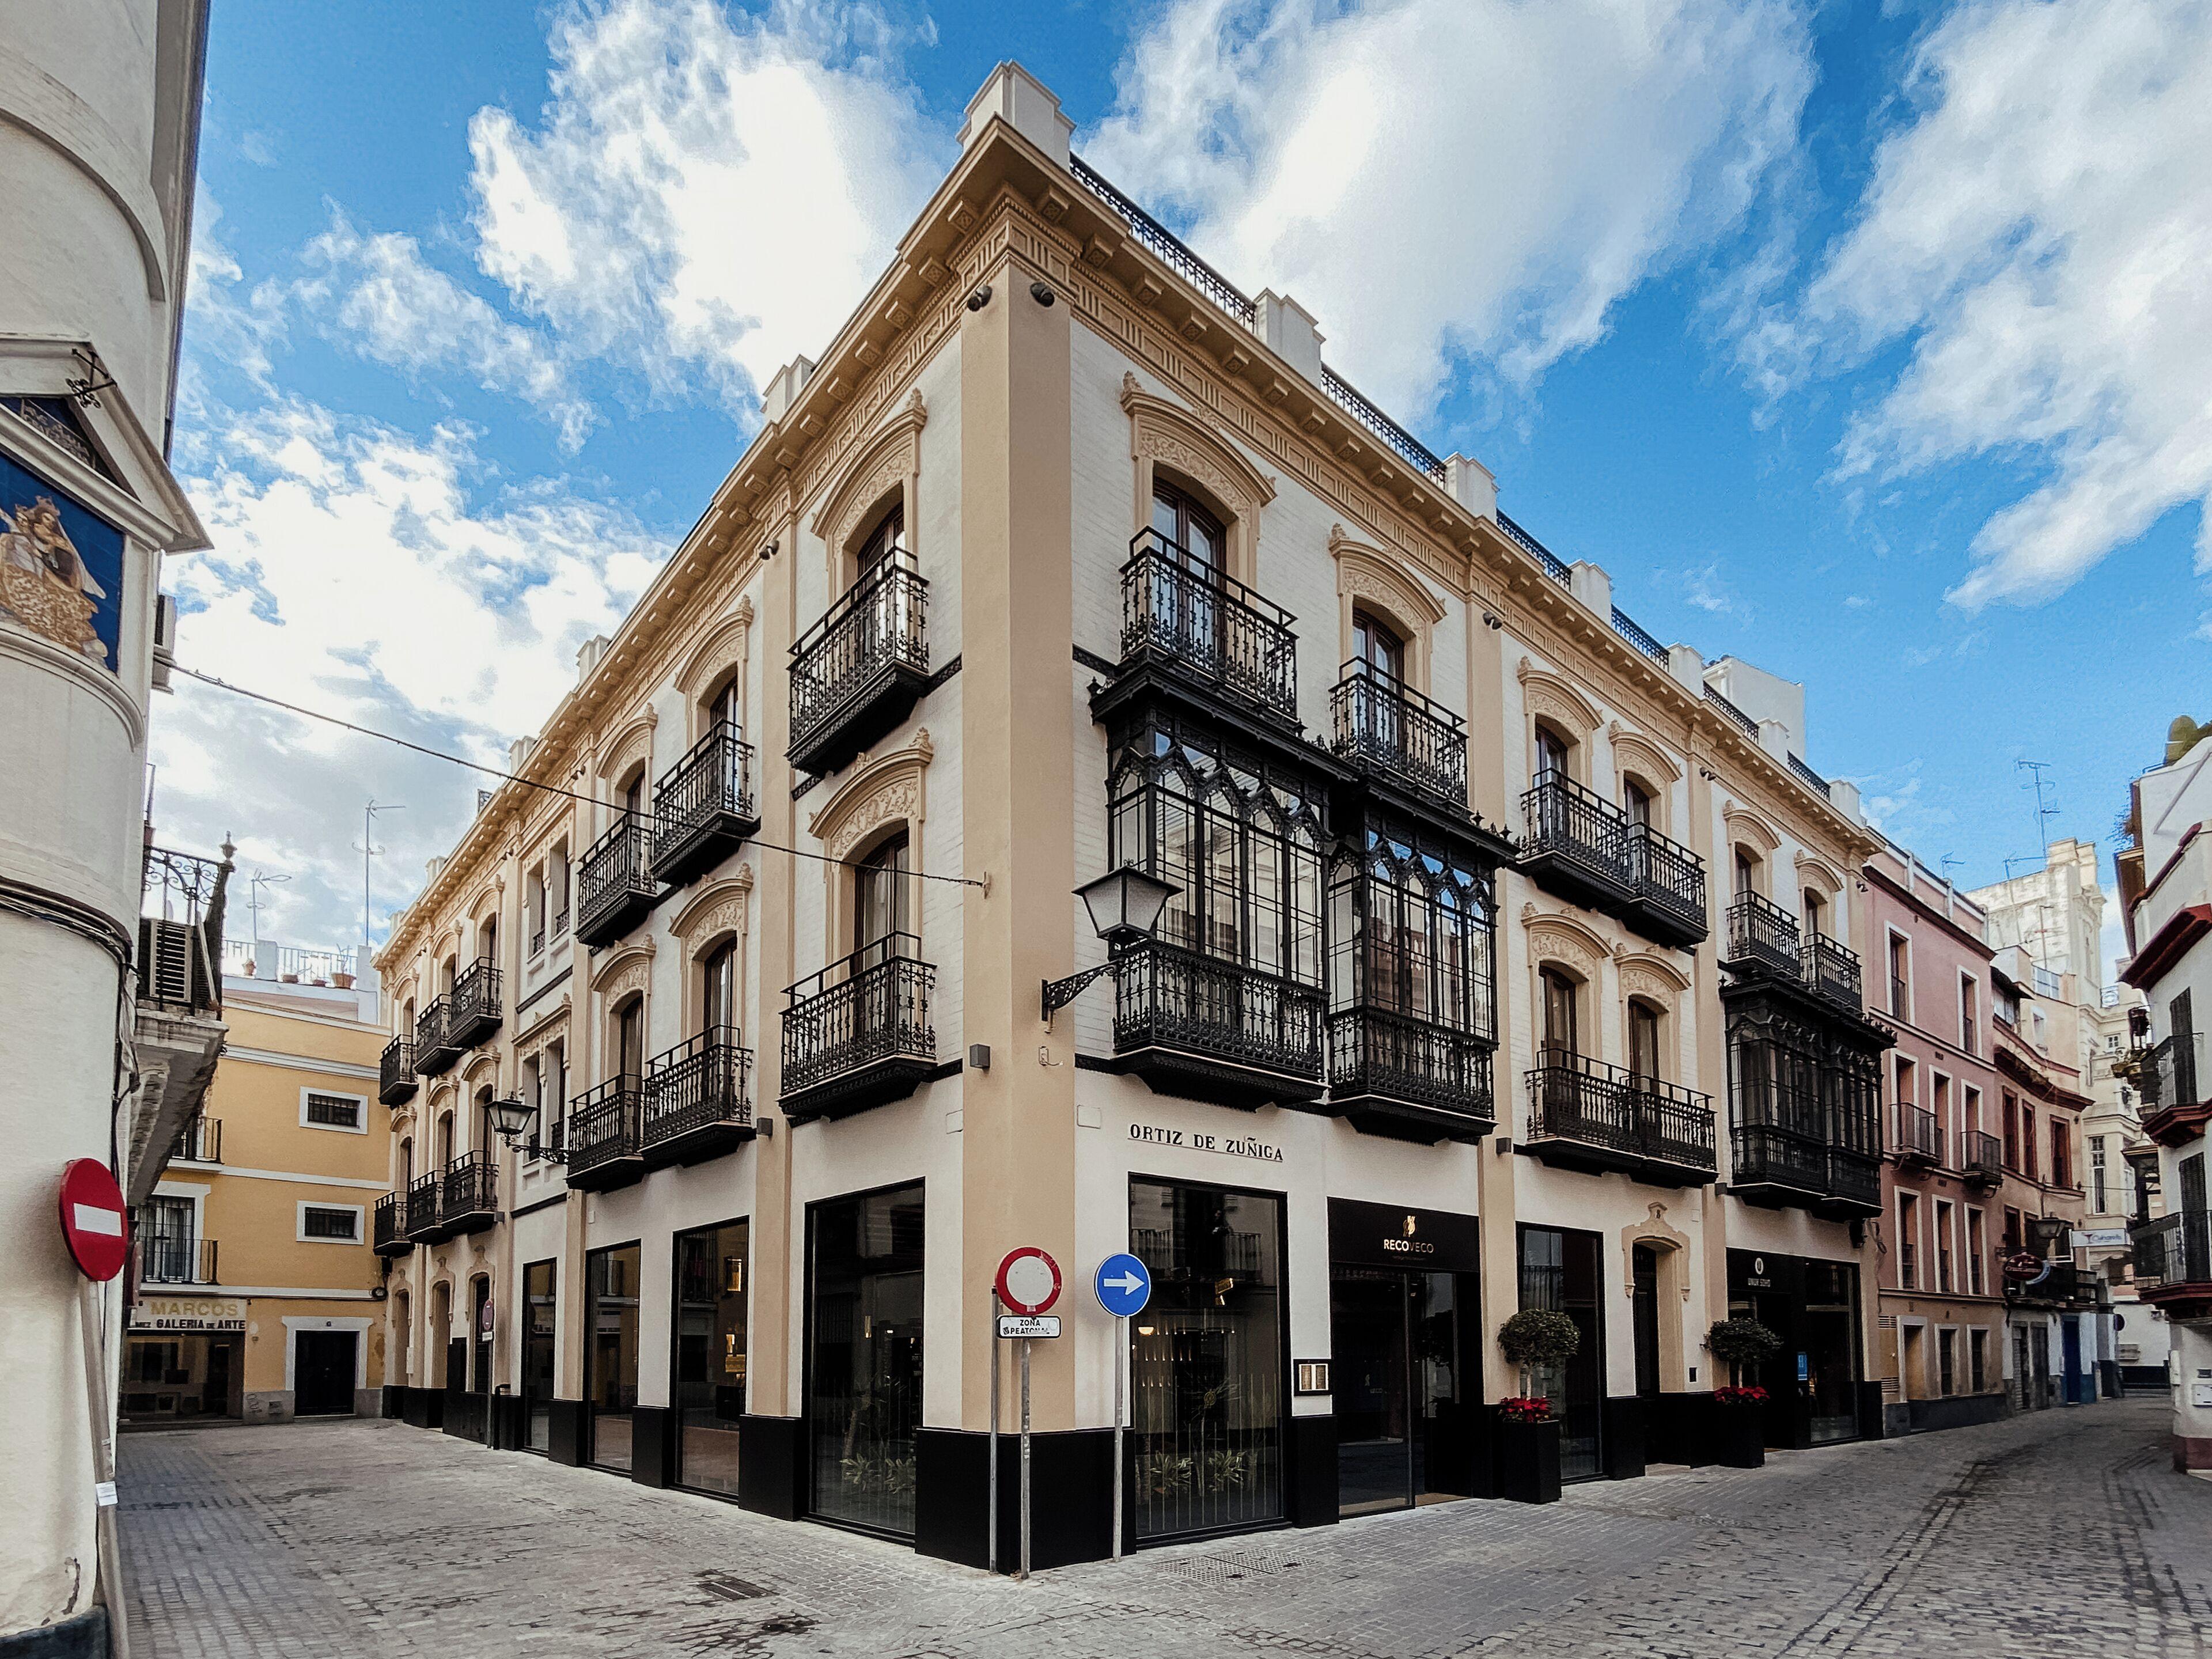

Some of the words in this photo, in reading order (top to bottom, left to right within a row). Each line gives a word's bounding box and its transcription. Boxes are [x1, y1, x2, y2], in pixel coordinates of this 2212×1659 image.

[1130, 1123, 1183, 1145] ORTIZ
[1194, 1134, 1215, 1150] DE
[1226, 1137, 1283, 1161] ZUÑIGA
[1384, 1238, 1434, 1253] RECOVECO
[150, 1300, 238, 1316] MARCOS
[156, 1319, 204, 1329] GALERIA
[218, 1320, 246, 1330] ARTE
